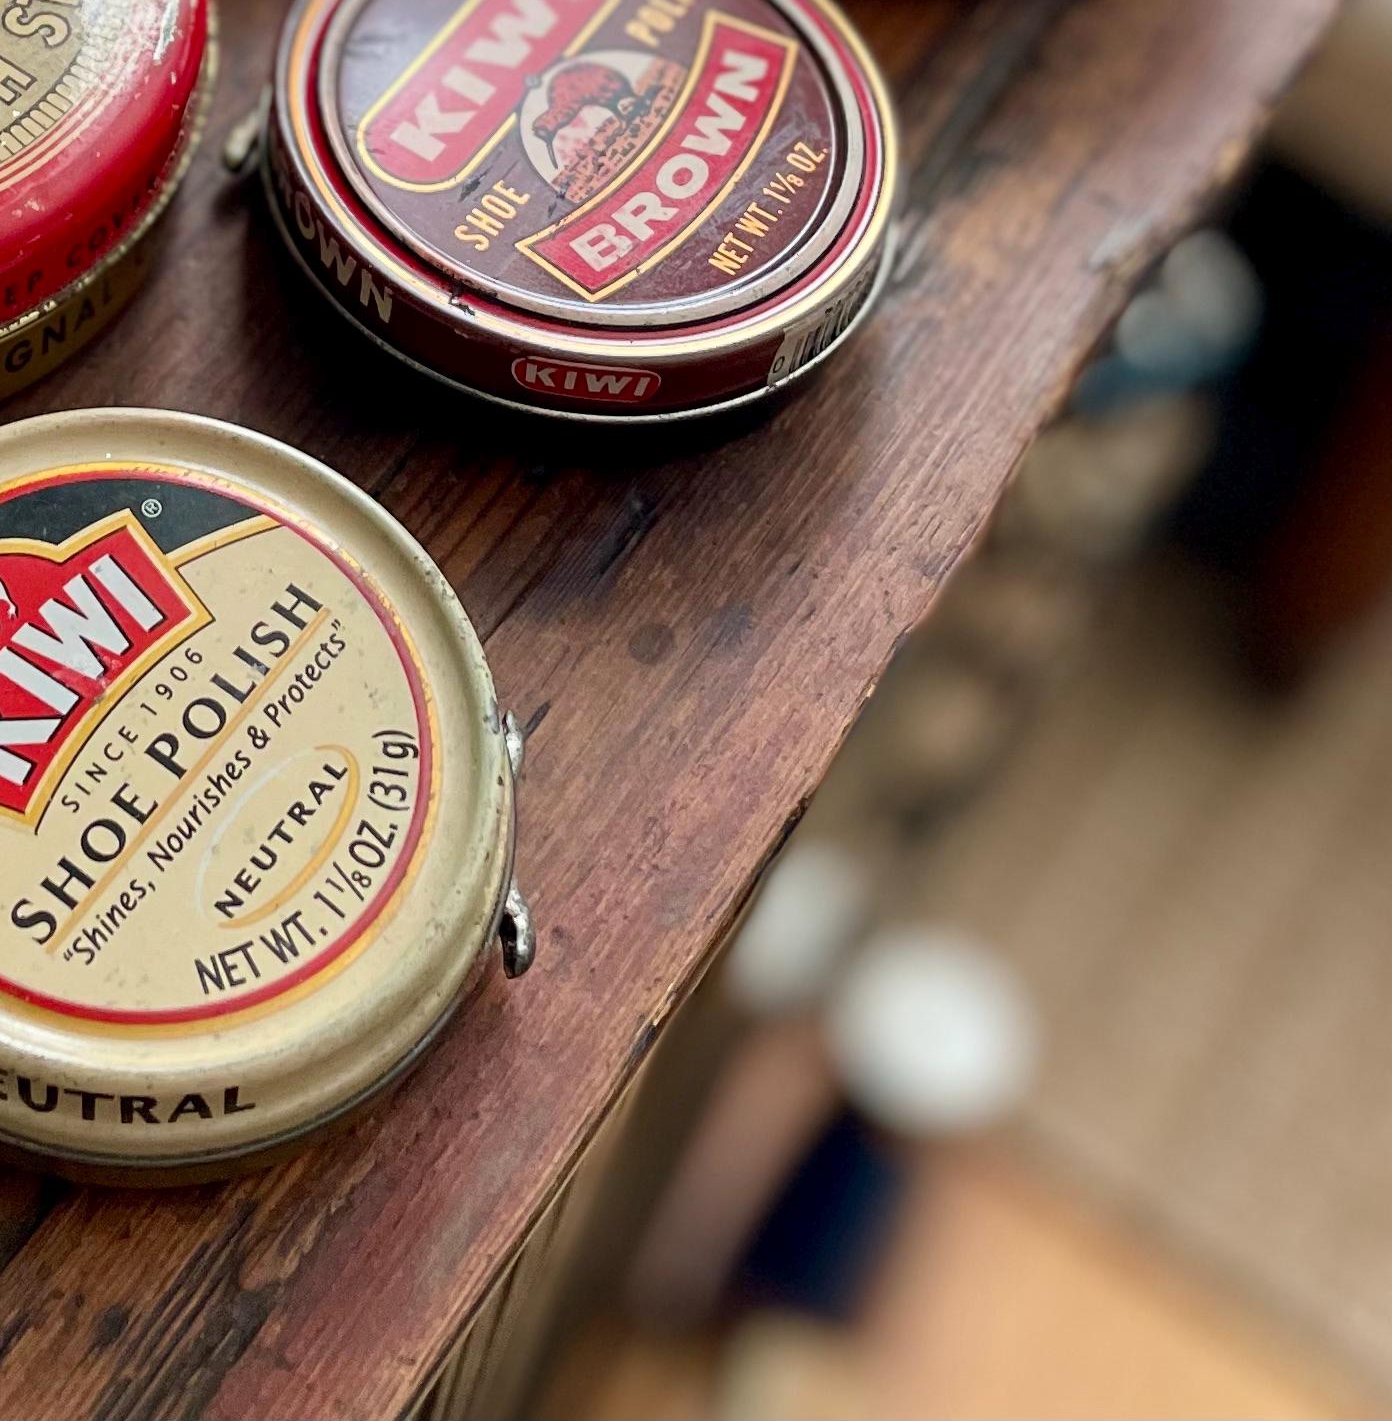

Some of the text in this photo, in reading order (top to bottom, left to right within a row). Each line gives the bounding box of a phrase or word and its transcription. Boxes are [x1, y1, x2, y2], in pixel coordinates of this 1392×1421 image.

[454, 179, 531, 253] SHOE
[569, 48, 769, 273] BROWN
[708, 231, 755, 276] NET
[525, 364, 651, 398] KIWI
[10, 583, 324, 945] SHOE POLISH
[61, 646, 206, 813] SINCE 1906
[147, 750, 253, 871] Nourishes
[247, 724, 271, 751] &
[194, 940, 261, 995] NET
[259, 910, 329, 965] WT.
[348, 819, 399, 869] OZ.
[214, 762, 348, 919] NEUTRAL
